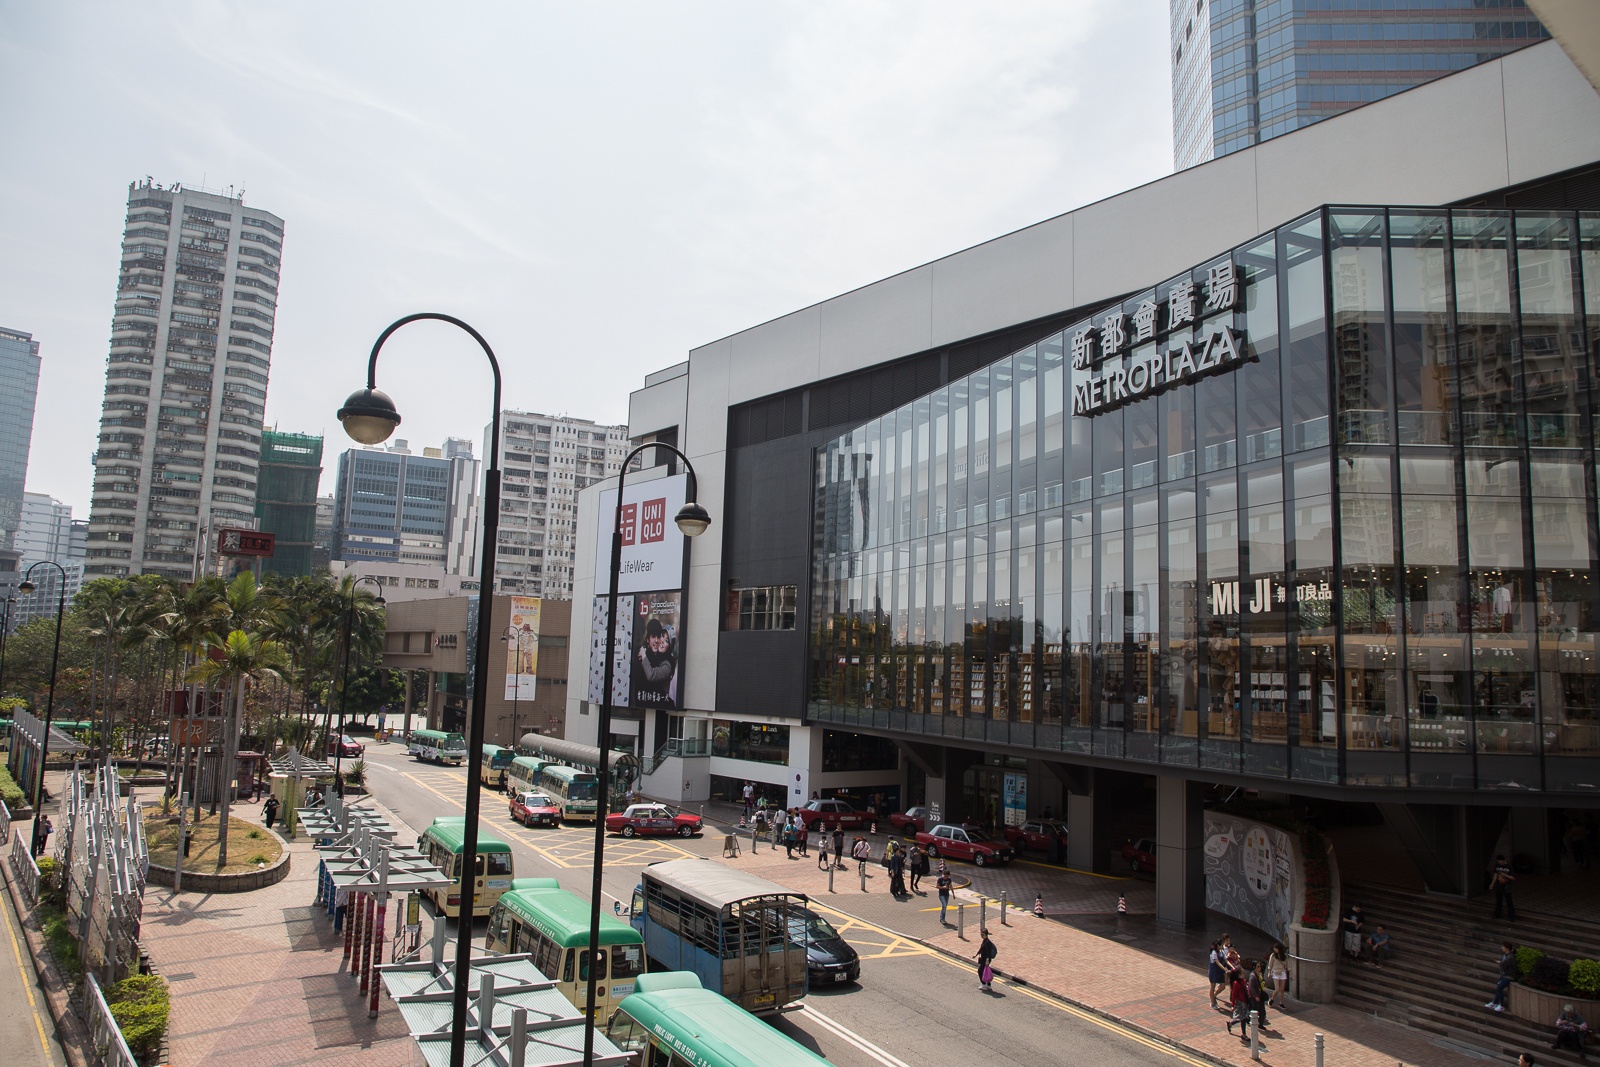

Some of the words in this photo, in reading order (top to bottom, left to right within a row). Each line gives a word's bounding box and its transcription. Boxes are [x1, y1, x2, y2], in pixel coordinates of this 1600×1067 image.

[1071, 259, 1238, 370] 新都會廣場
[1071, 324, 1239, 416] METROPLAZA
[644, 503, 662, 520] UNI
[643, 521, 662, 540] QLO
[620, 560, 654, 574] LifeWear
[601, 638, 622, 646] LOON
[653, 1023, 666, 1036] PUBLIC
[684, 1047, 697, 1061] SEATS
